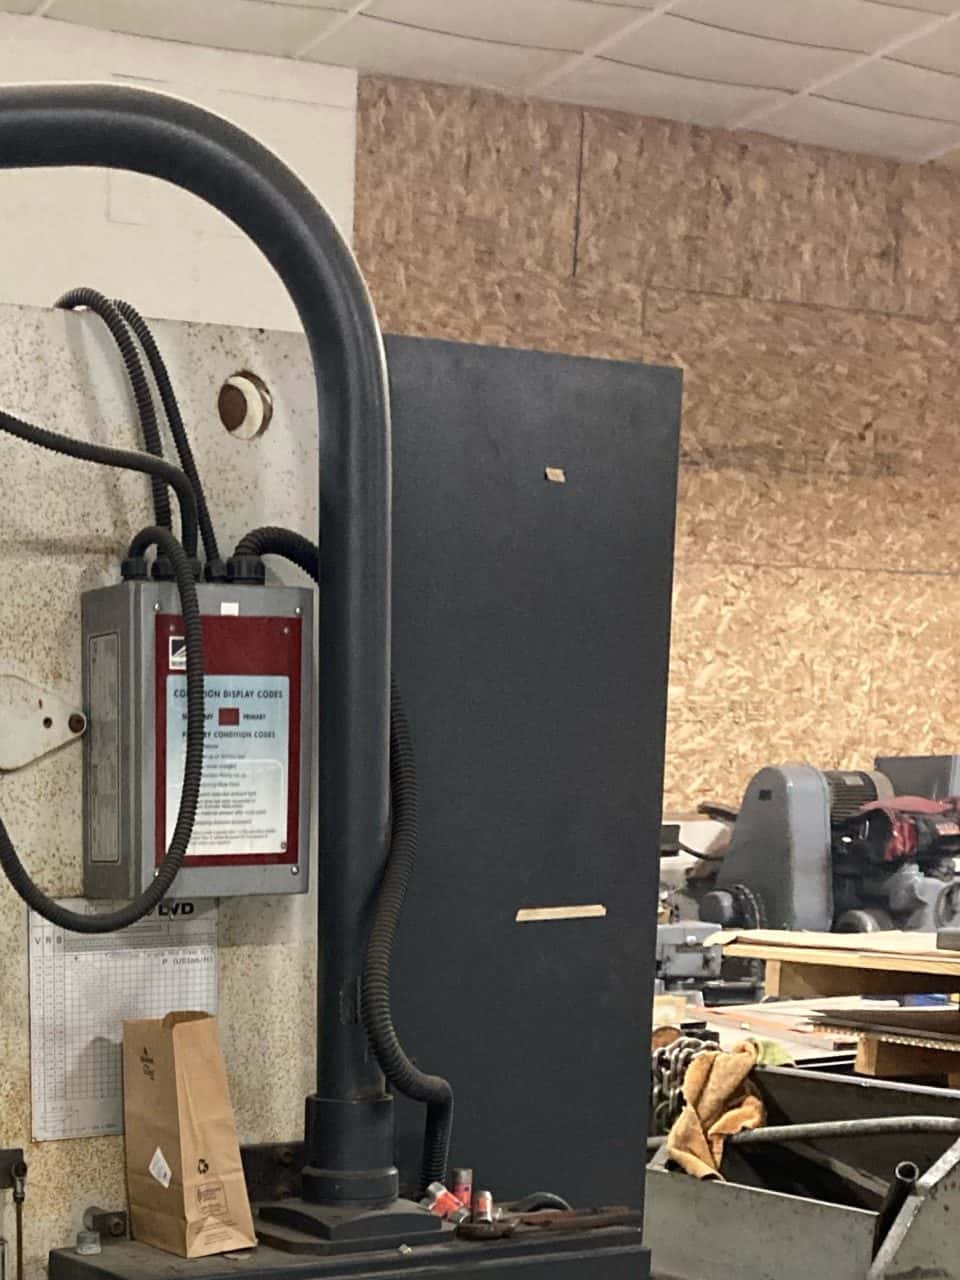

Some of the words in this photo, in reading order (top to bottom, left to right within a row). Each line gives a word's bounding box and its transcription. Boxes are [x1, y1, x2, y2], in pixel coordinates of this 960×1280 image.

[174, 689, 220, 698] COION
[224, 690, 254, 698] DISPLAY
[257, 690, 283, 698] CODES
[158, 902, 194, 916] LVD
